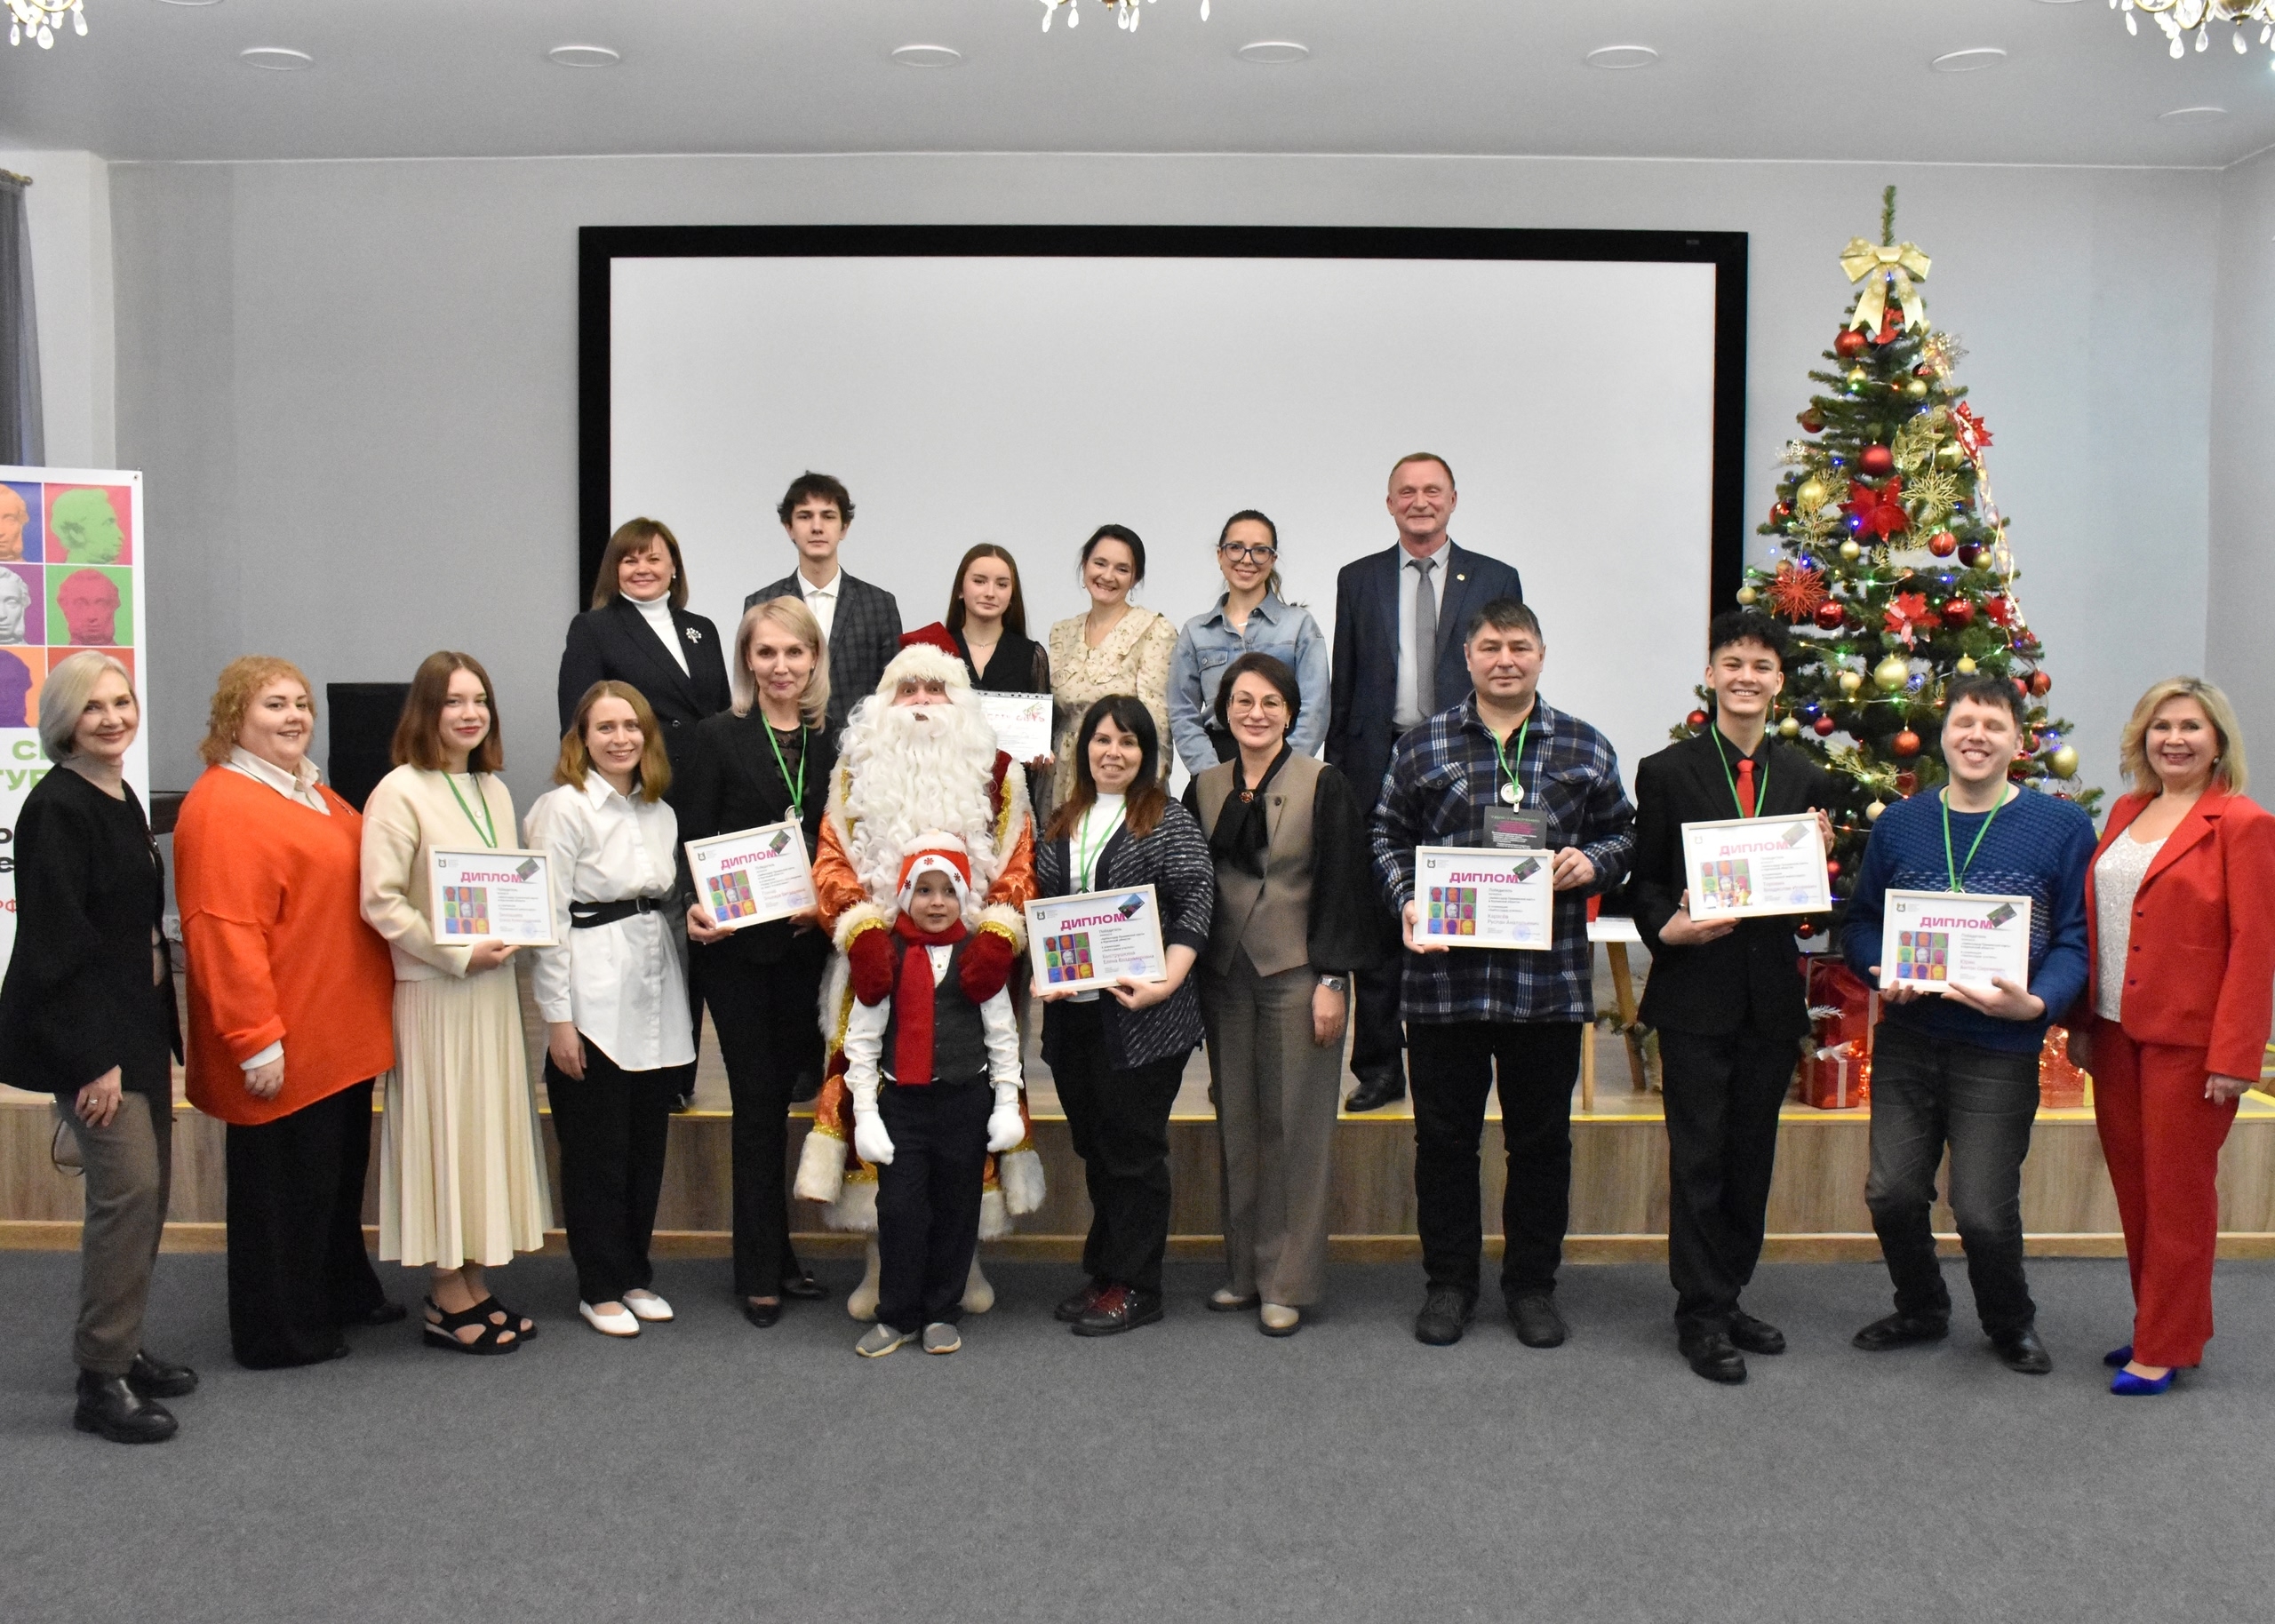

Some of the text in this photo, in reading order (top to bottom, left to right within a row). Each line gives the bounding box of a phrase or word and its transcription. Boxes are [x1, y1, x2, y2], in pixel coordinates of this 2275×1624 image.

[1719, 840, 1789, 856] ДИПЛОМ
[721, 849, 778, 871] ДИПЛОМ
[461, 872, 523, 883] ДИПЛОМ
[1449, 872, 1519, 884] ДИПЛОМ
[1060, 912, 1127, 931] ДИПЛОМ
[1920, 916, 1993, 930] ДИПЛОМ
